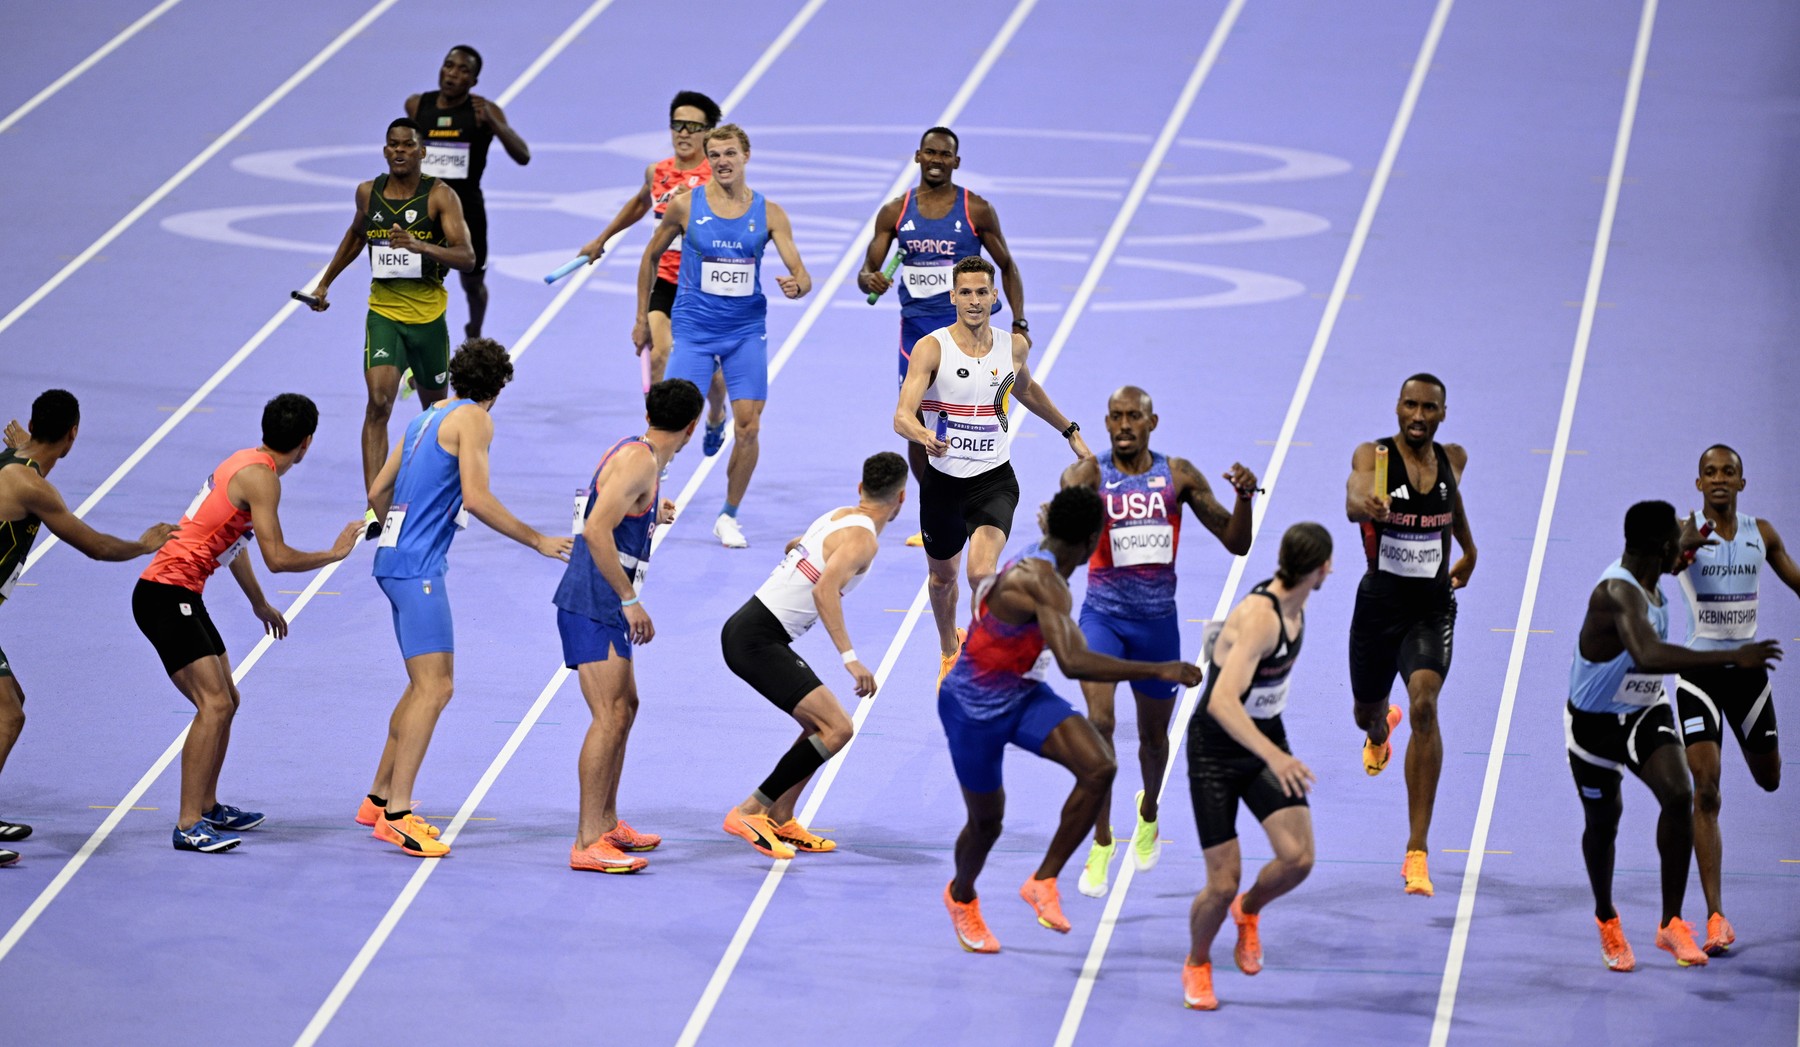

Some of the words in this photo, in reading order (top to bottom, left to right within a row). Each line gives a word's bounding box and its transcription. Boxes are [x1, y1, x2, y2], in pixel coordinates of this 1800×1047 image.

[366, 230, 391, 239] SOUT
[712, 239, 743, 250] ITALIA
[906, 239, 957, 256] FRANCE
[378, 253, 410, 266] NENE
[711, 270, 749, 284] ACETI
[909, 273, 947, 286] BIRON
[950, 436, 995, 452] ORLEE
[1106, 491, 1167, 520] USA
[1389, 511, 1418, 527] REAT
[1113, 533, 1171, 552] NORWOOD
[1380, 543, 1441, 564] HUDSON-SMITH
[1701, 563, 1758, 577] BOTSWANA
